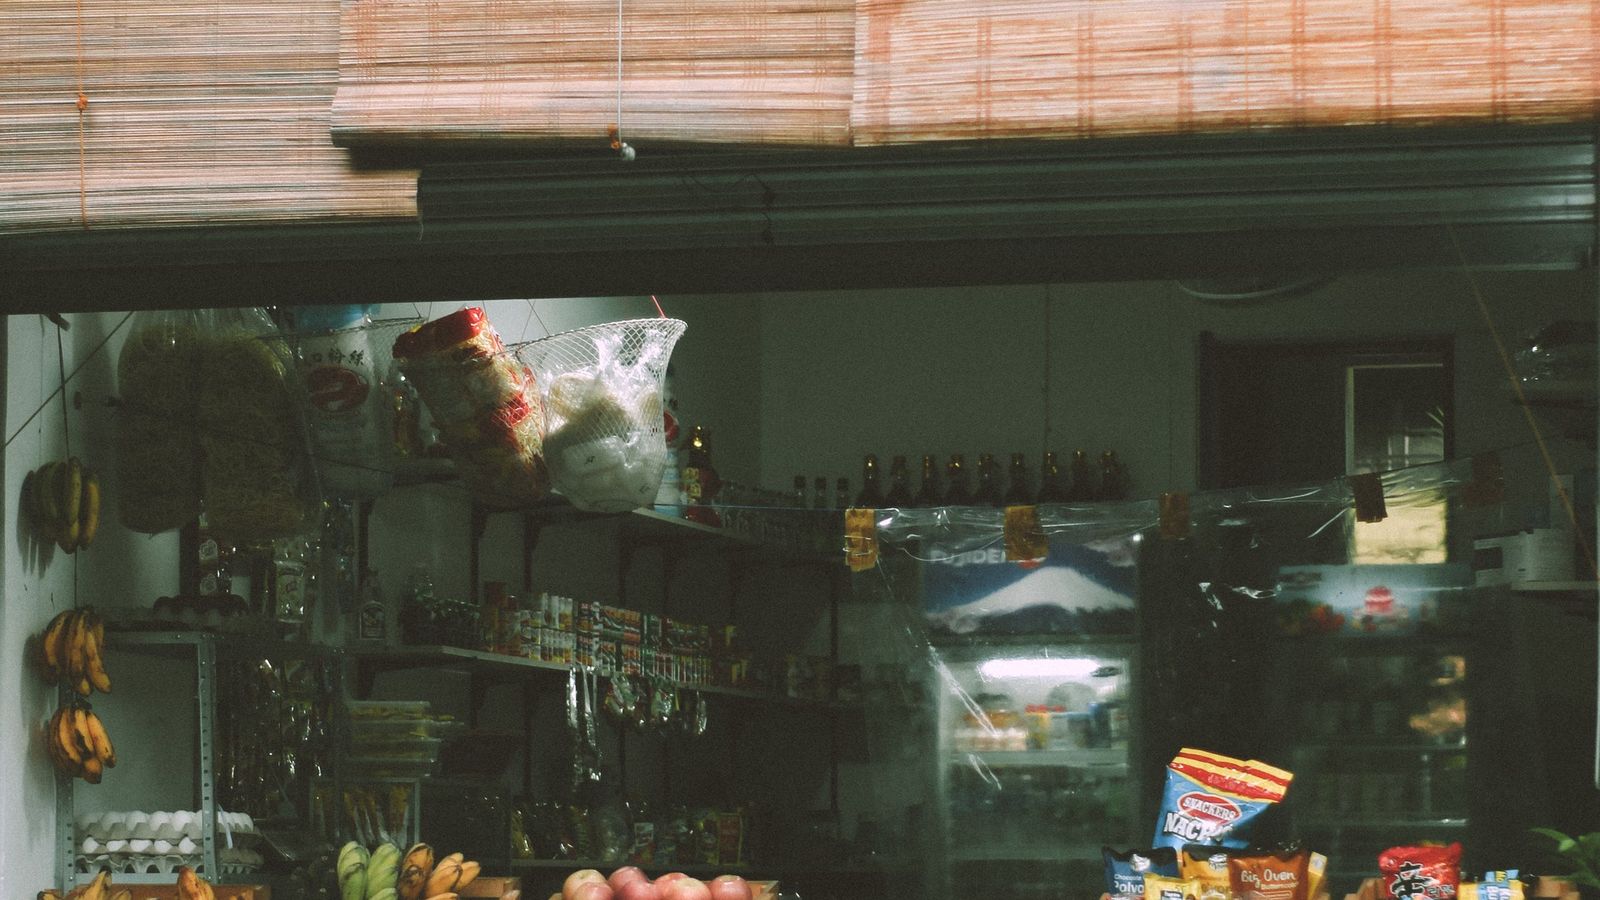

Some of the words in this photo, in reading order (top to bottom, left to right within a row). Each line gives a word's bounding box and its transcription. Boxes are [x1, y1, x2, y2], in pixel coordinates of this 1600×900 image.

[1182, 796, 1236, 821] SNACKERS
[1241, 869, 1260, 889] Big
[1263, 868, 1297, 882] Oven
